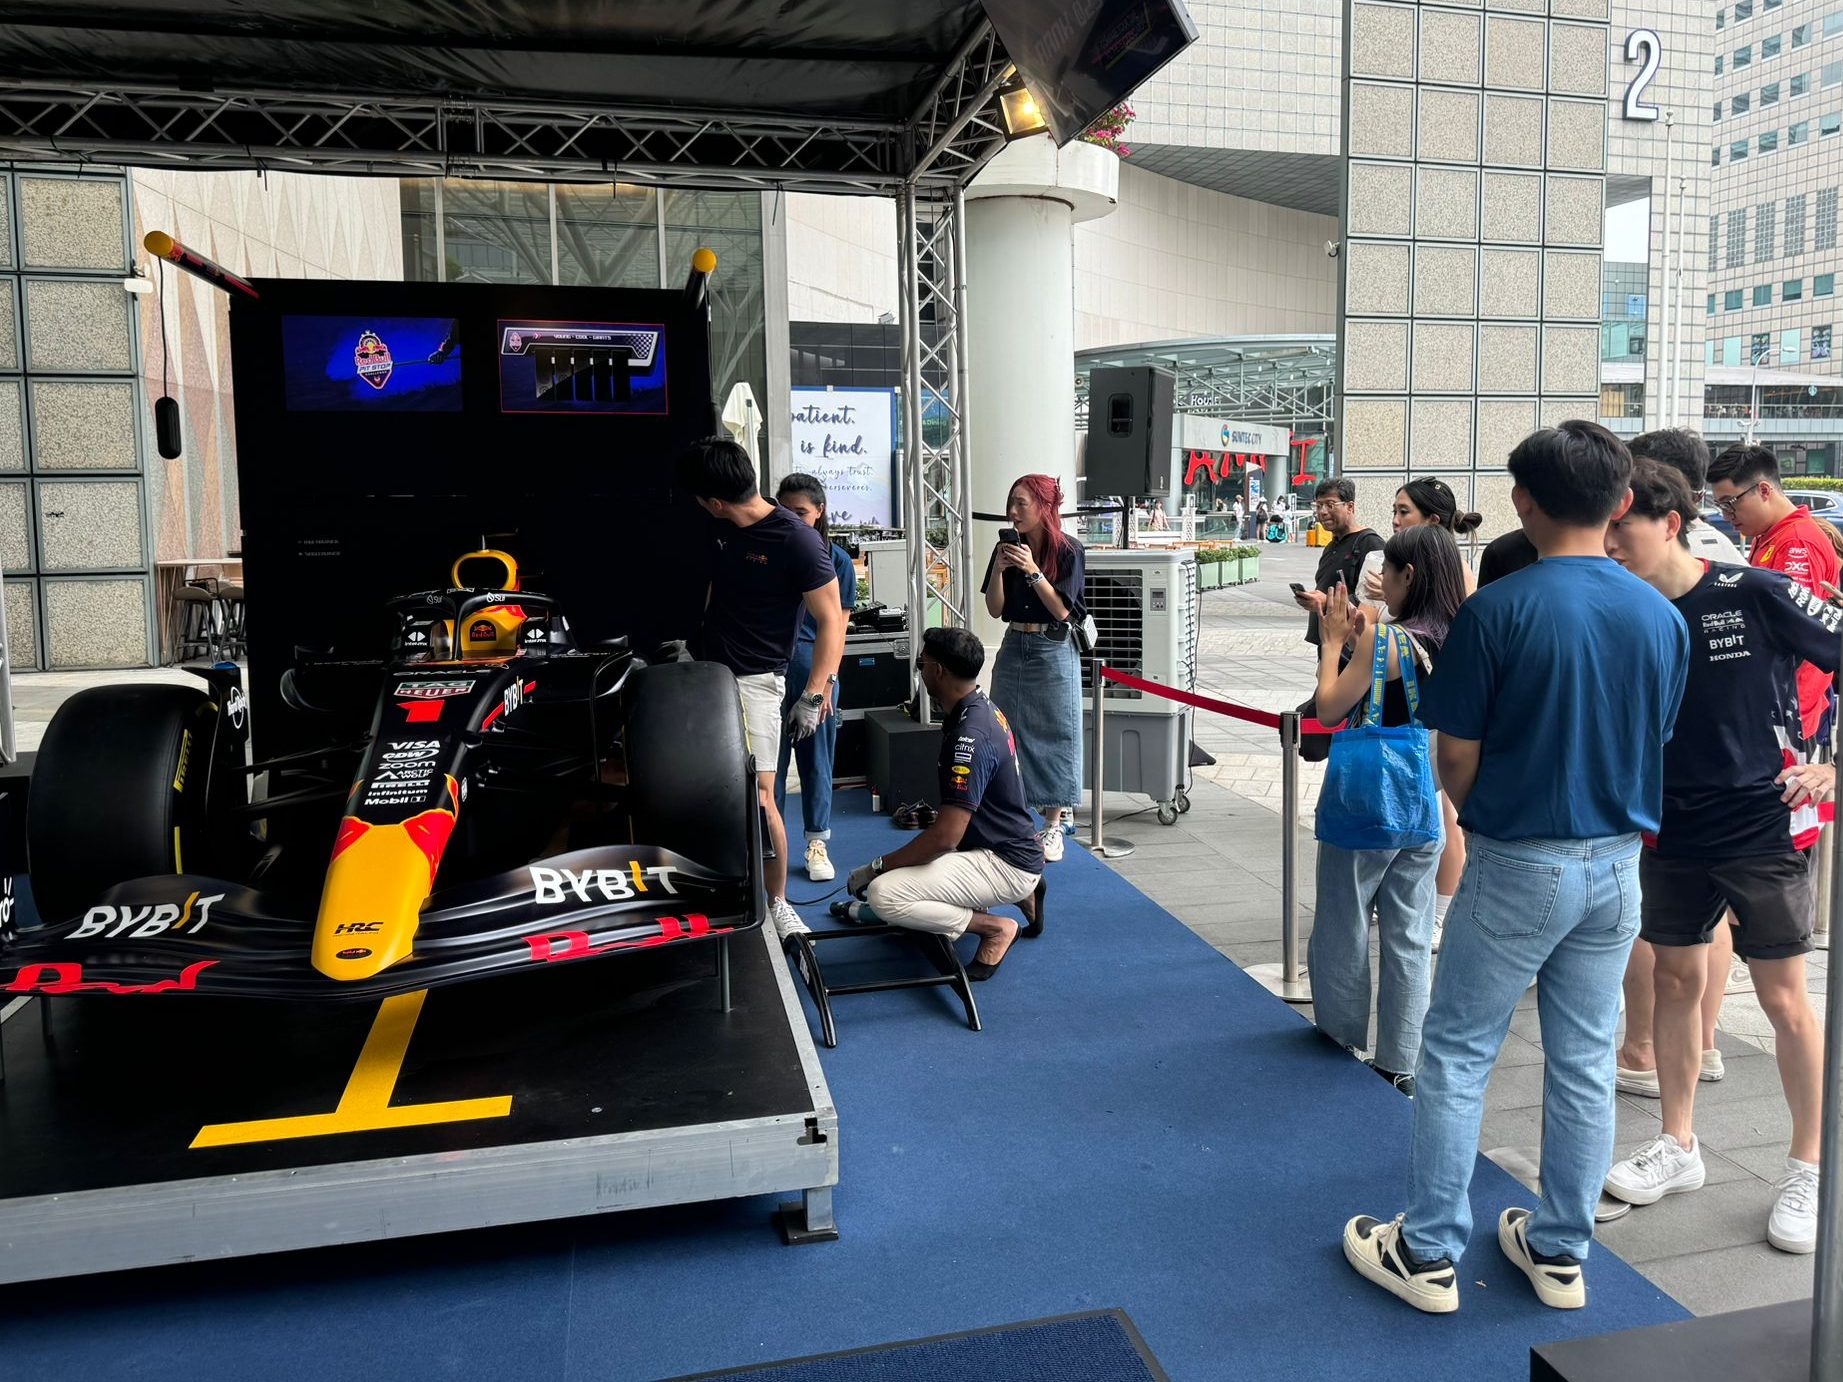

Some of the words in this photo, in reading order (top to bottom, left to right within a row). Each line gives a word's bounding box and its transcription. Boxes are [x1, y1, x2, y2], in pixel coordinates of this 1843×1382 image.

[1622, 28, 1661, 120] 2
[1232, 430, 1251, 444] SUNTEC
[1252, 432, 1262, 446] CITY
[800, 440, 815, 454] is
[820, 433, 868, 459] kind.
[811, 465, 844, 483] always
[823, 483, 873, 492] erseveres.
[828, 510, 853, 524] ve
[1701, 609, 1743, 621] ORACLE
[1709, 634, 1745, 650] BYBIT
[1709, 650, 1752, 662] HONDA
[393, 668, 492, 677] ORACLE
[399, 687, 468, 697] HEUER
[504, 675, 524, 717] BYBIT
[396, 699, 446, 723] 1
[387, 740, 441, 750] VISA
[364, 796, 409, 806] Mobil
[529, 860, 679, 904] BYBIT
[64, 892, 225, 939] BYBIT
[333, 921, 384, 935] HRC
